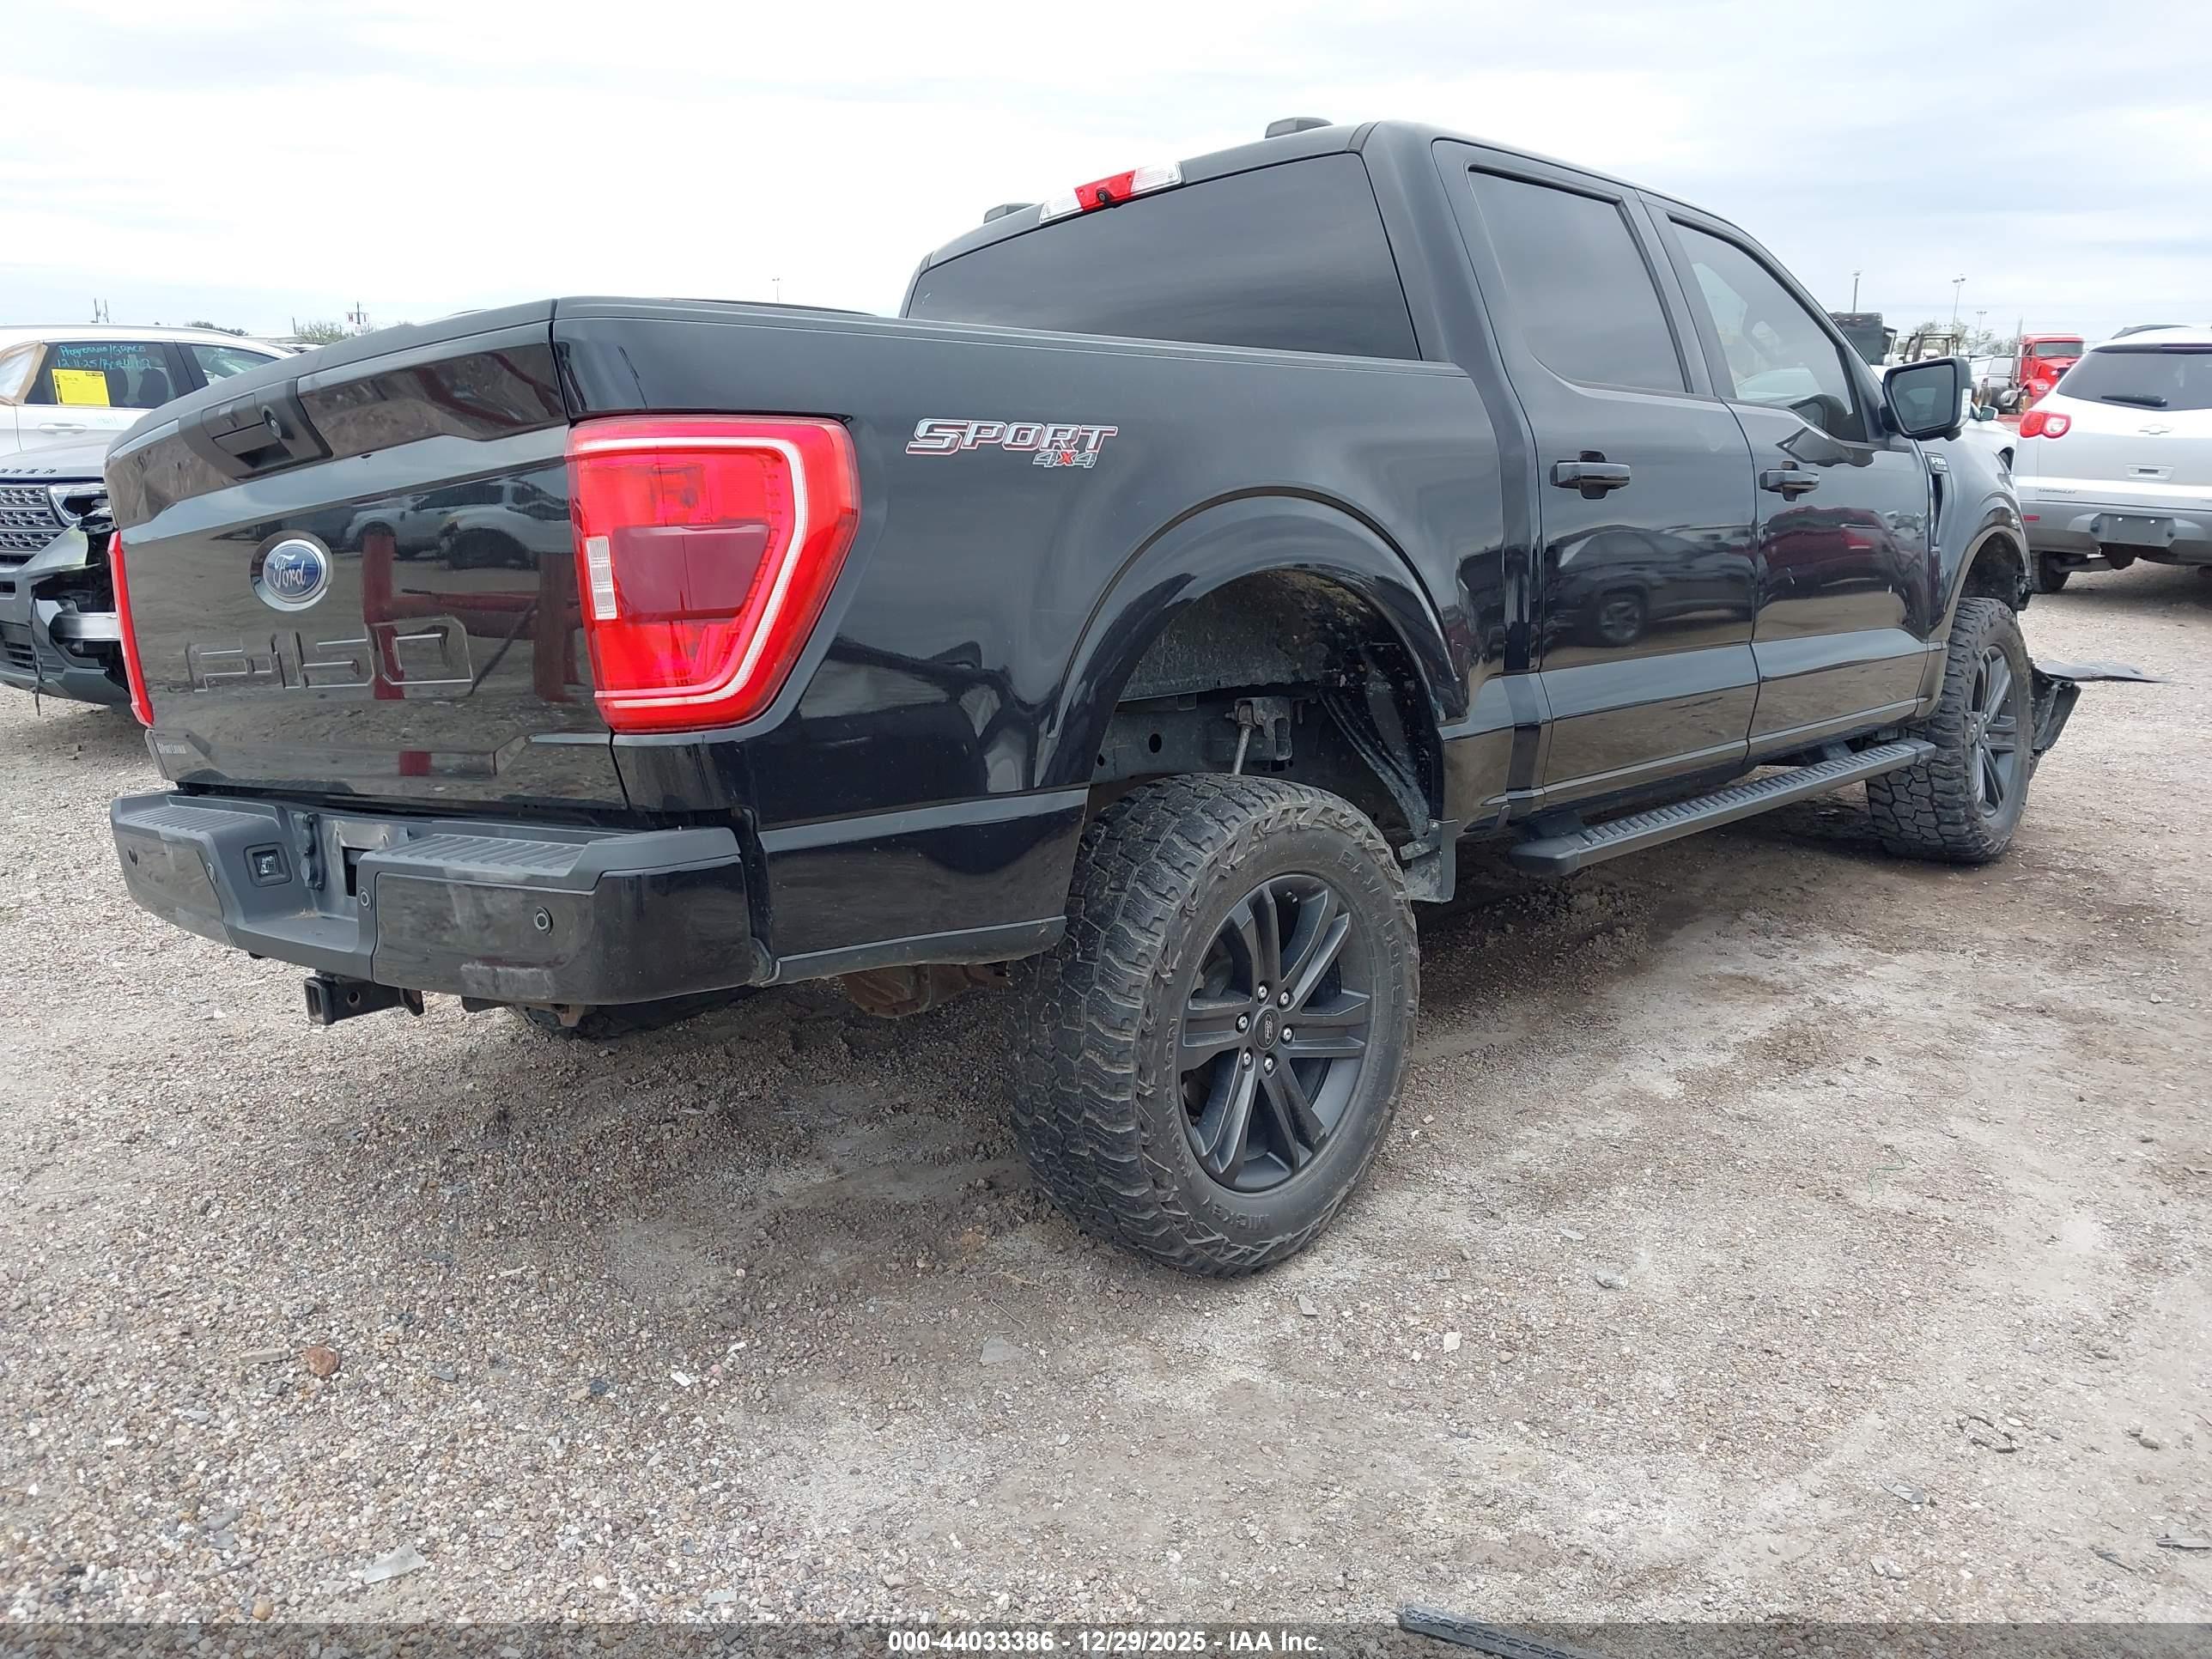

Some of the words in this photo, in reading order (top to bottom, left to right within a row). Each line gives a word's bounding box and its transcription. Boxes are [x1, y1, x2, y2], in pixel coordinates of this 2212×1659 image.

[905, 417, 1119, 455] SPORT
[273, 554, 307, 589] Ford
[185, 616, 473, 697] F-150
